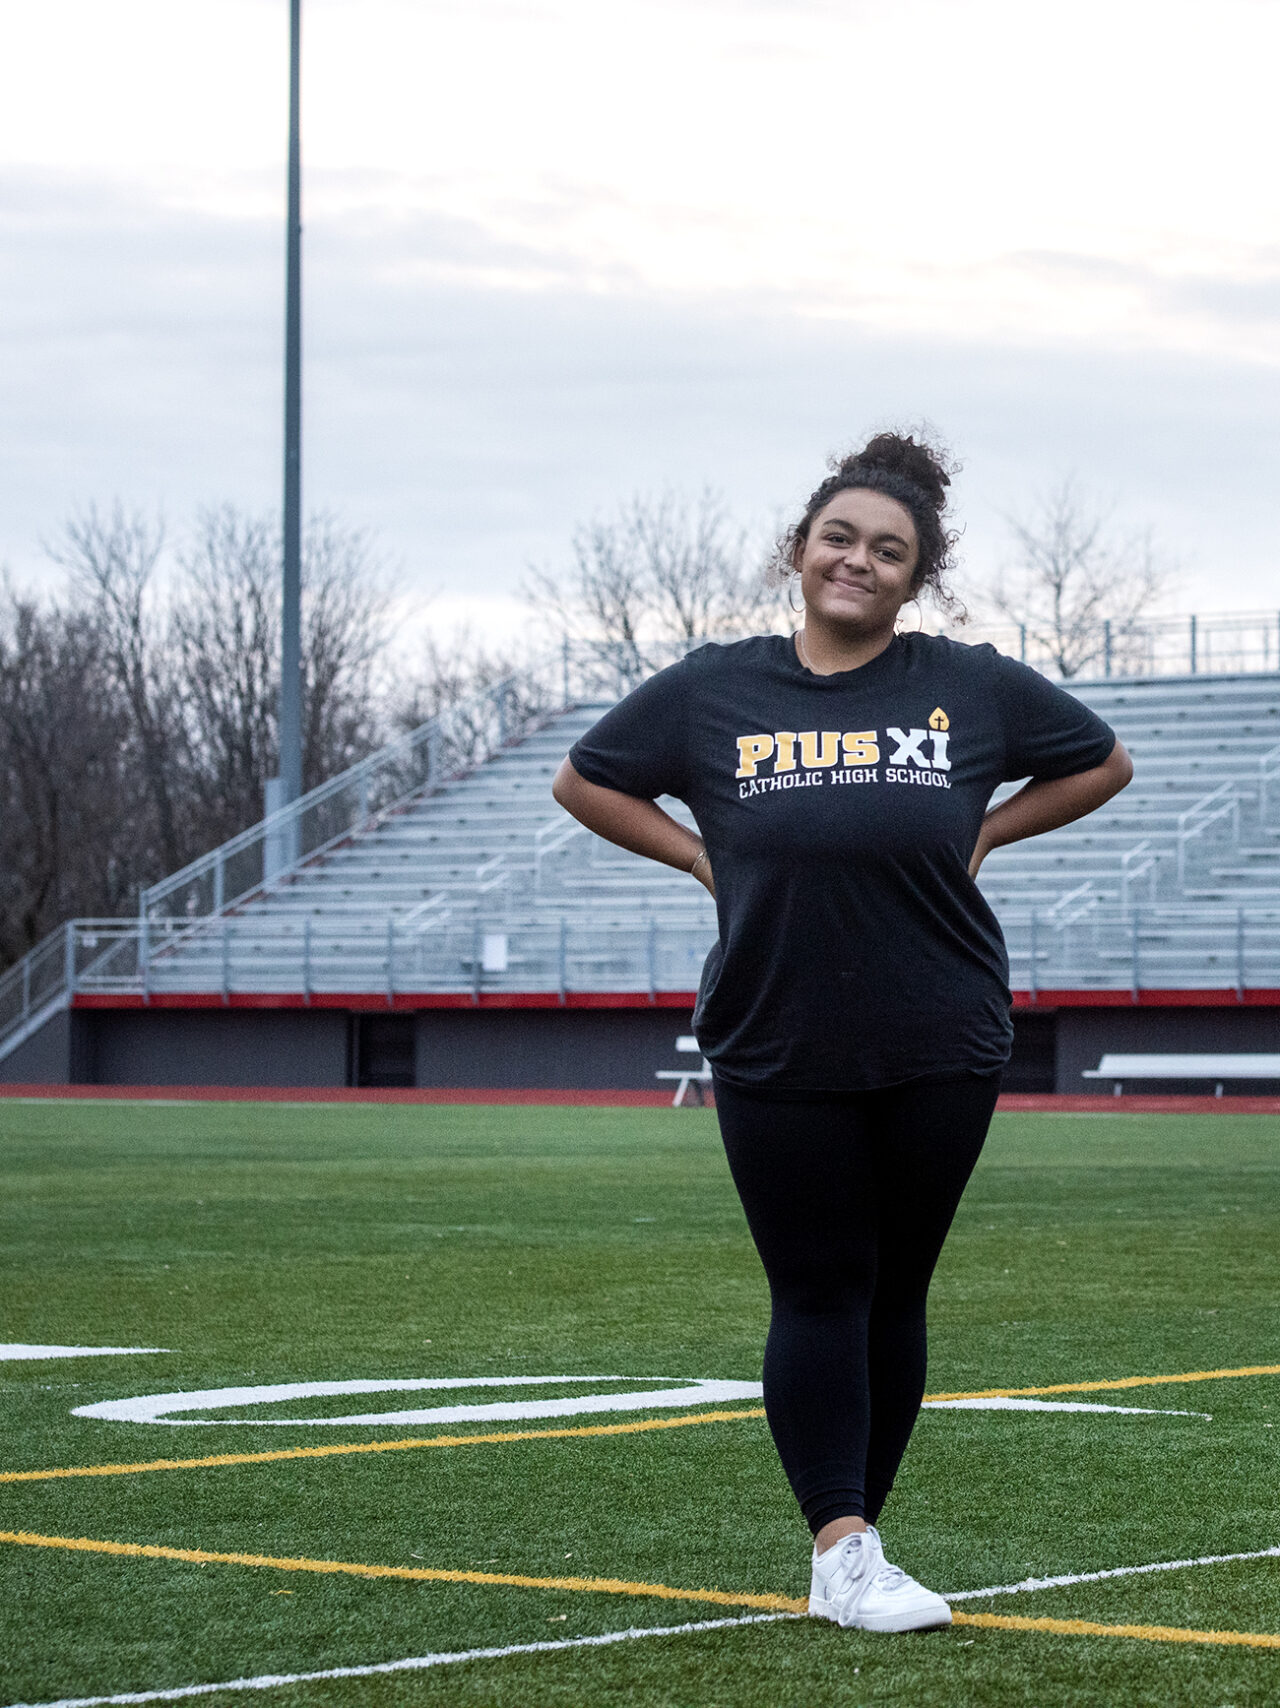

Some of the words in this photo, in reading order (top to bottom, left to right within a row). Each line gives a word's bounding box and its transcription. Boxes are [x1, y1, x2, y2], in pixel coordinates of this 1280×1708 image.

[735, 731, 880, 779] PIUS
[886, 727, 952, 771] XI
[738, 771, 824, 799] CATHOLIC
[830, 768, 879, 785] HIGH
[885, 768, 952, 789] SCHOOL
